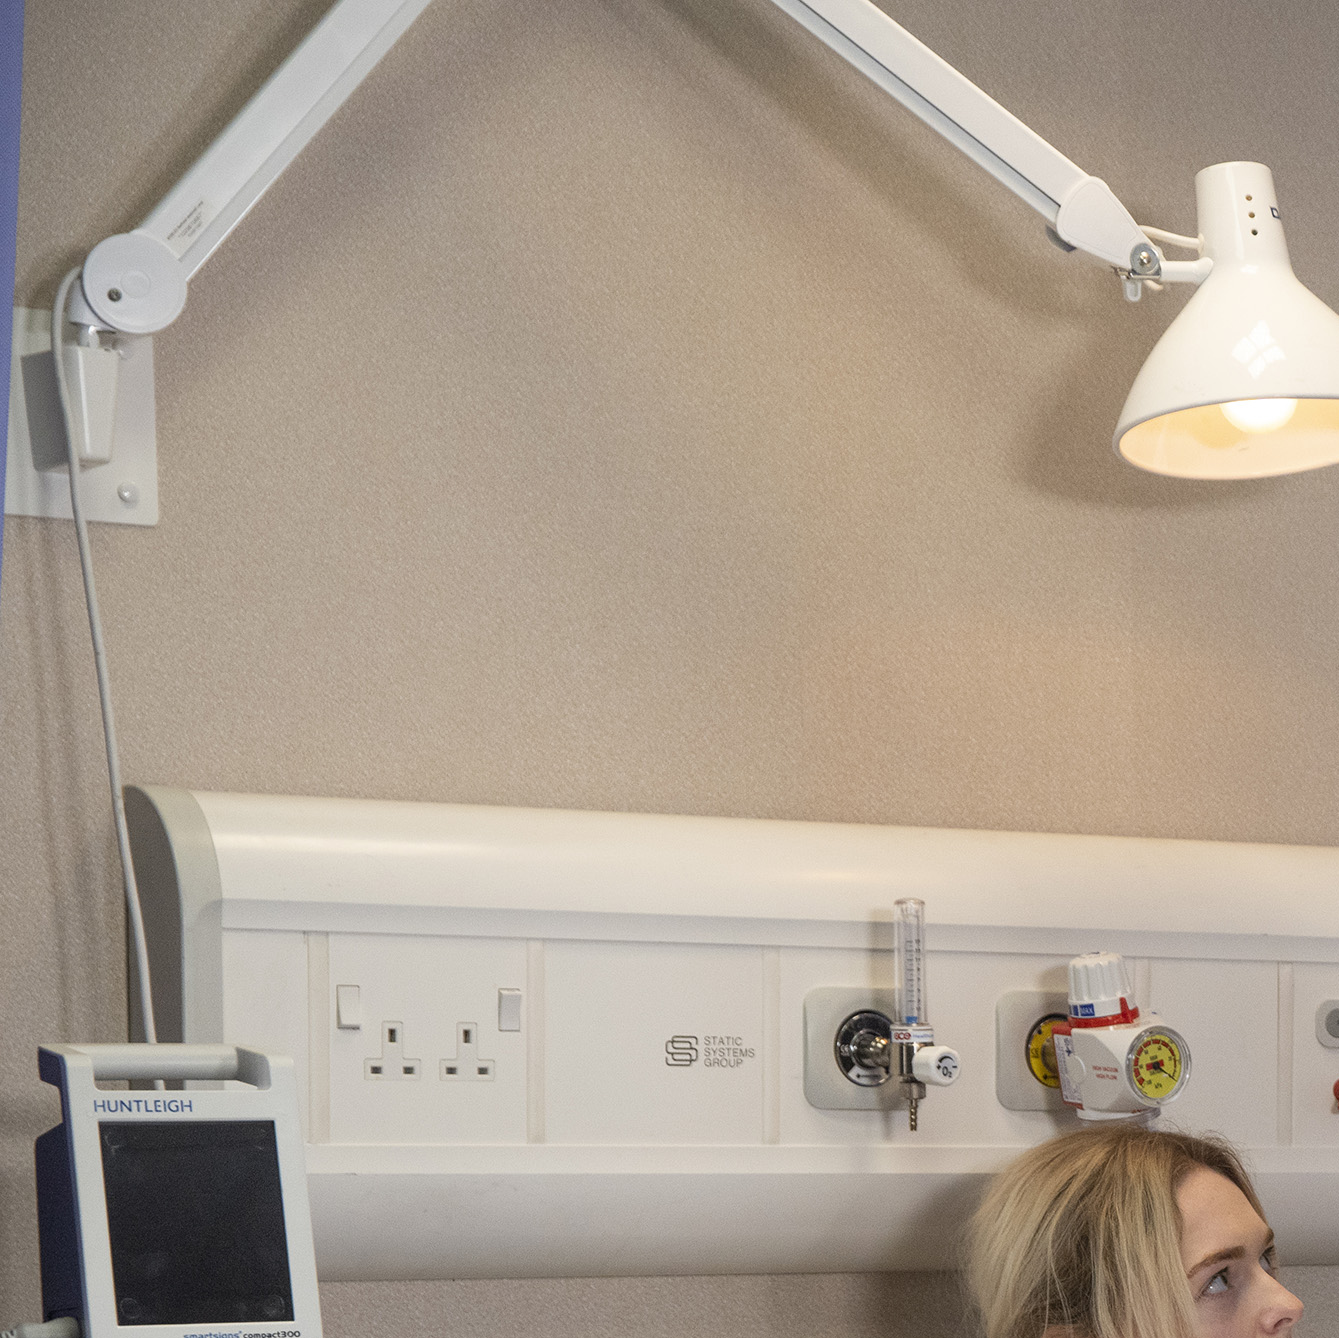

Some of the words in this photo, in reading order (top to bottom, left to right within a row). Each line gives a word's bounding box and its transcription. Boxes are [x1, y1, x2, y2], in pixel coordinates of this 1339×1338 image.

[703, 1035, 743, 1046] STATIC
[703, 1047, 756, 1058] SYSTEMS
[703, 1057, 744, 1068] GROUP
[93, 1099, 193, 1113] HUNTLEIGH
